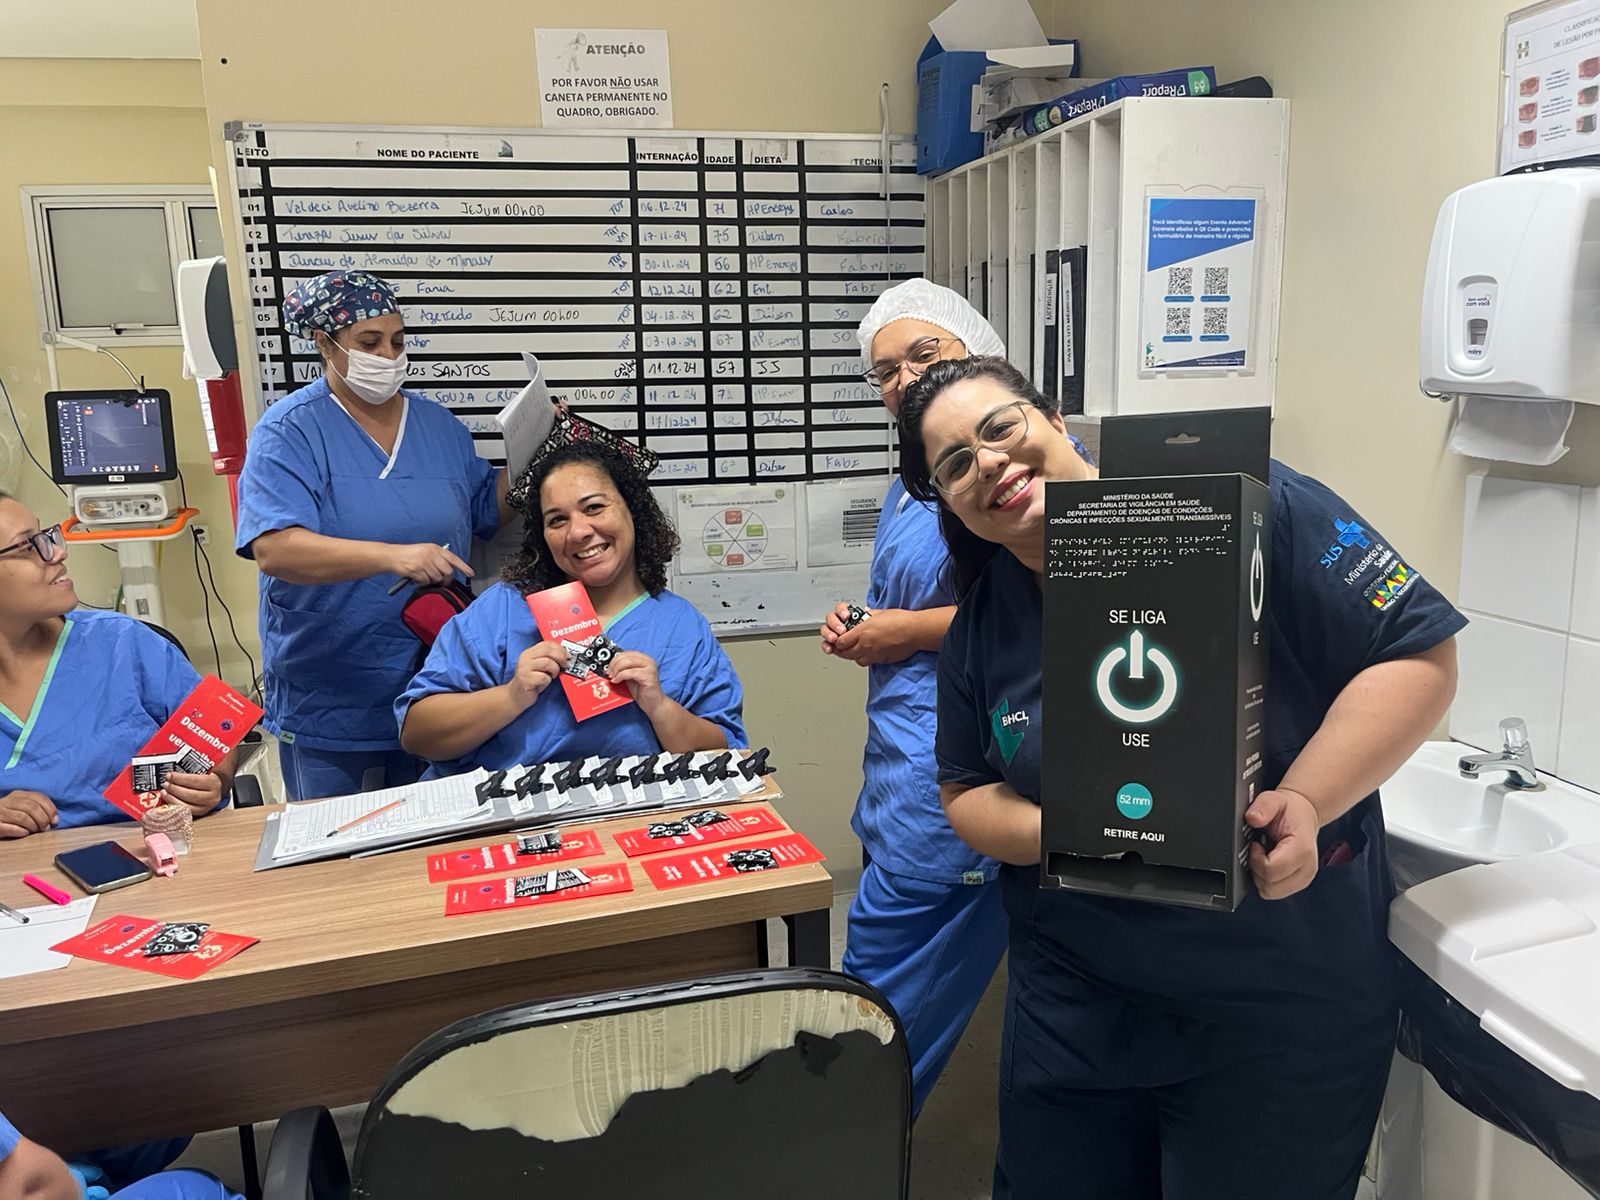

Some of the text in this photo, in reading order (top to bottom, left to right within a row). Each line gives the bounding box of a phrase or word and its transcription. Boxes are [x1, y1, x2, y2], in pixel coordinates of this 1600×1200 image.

[586, 42, 645, 57] ATENÇÃO
[552, 76, 659, 87] POR FAVOR NÃO USAR
[545, 92, 667, 102] CANETA PERMANENTE NO
[557, 107, 659, 118] QUADRO, OBRIGADO.
[237, 147, 269, 157] LEITO
[377, 149, 479, 159] NOME DO PACIENTE
[636, 151, 698, 162] INTERNAÇÃO
[705, 155, 735, 164] IDADE
[754, 156, 782, 164] DIETA
[432, 363, 491, 378] SANTOS
[715, 361, 736, 374] 57
[1103, 493, 1140, 501] MINISTÉRIO
[1151, 492, 1174, 500] SAÚDE
[1128, 500, 1165, 508] VIGILÂNCIA
[1067, 509, 1117, 517] DEPARTAMENTO
[1128, 508, 1160, 516] DOENÇAS
[1172, 506, 1212, 515] CONDIÇÕES
[1050, 516, 1082, 524] CRÔNICAS
[1089, 515, 1125, 524] INFECÇÕES
[1126, 515, 1175, 523] SEXUALMENTE
[1176, 513, 1232, 521] TRANSMISSÍVEIS
[1320, 543, 1343, 569] SUS
[1109, 610, 1166, 625] SE LIGA
[550, 617, 598, 638] Dezembro
[180, 715, 231, 755] Dezembro
[1122, 733, 1150, 747] USE
[1119, 794, 1150, 805] 52 mm
[1104, 827, 1165, 843] RETIRE AQUI
